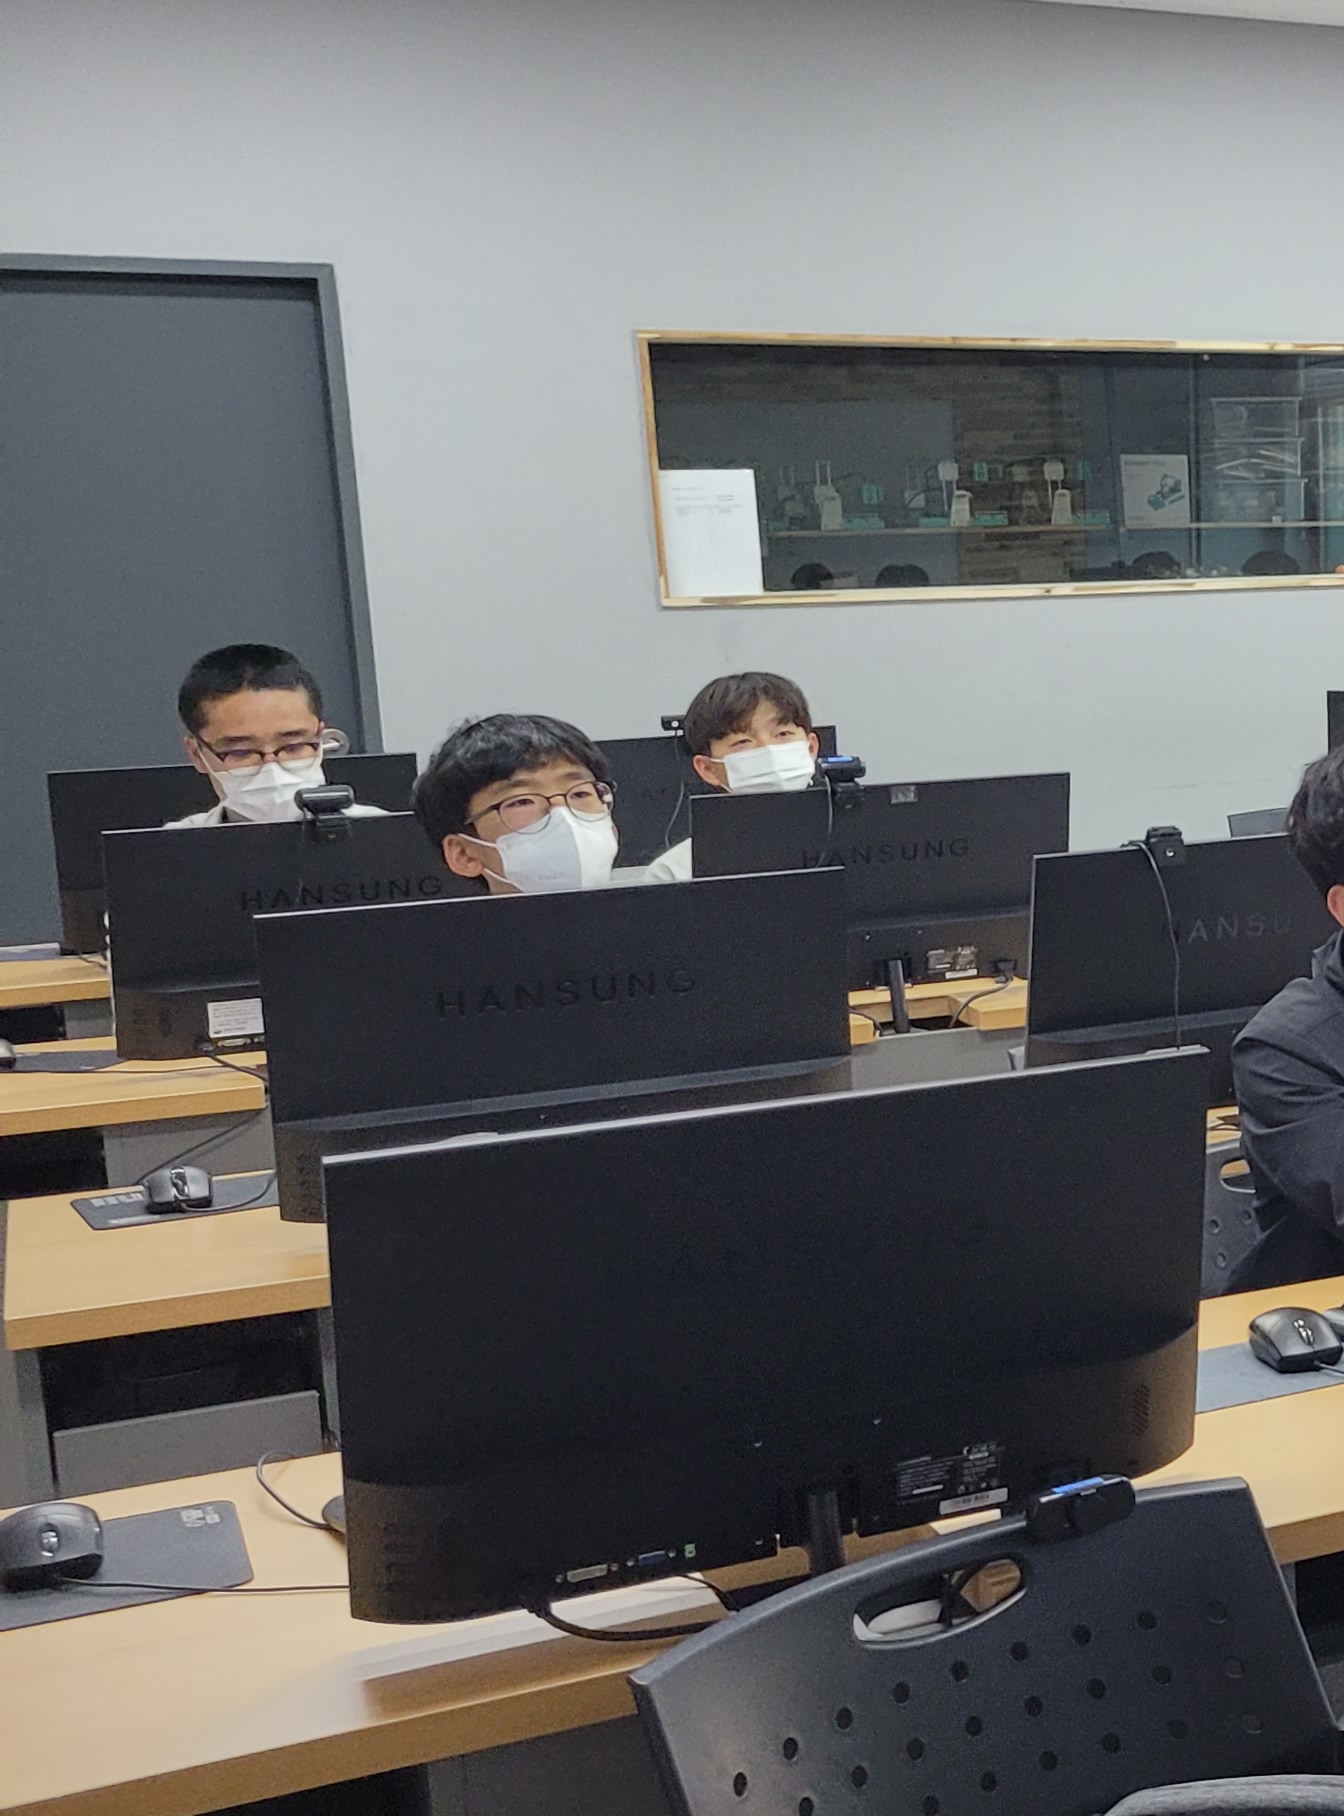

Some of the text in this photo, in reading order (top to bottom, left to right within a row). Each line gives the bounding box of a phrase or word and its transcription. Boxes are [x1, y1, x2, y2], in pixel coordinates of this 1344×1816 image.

[801, 838, 970, 869] HANSUNG
[241, 875, 442, 911] HANSUNG
[437, 967, 696, 1018] HANSUNG
